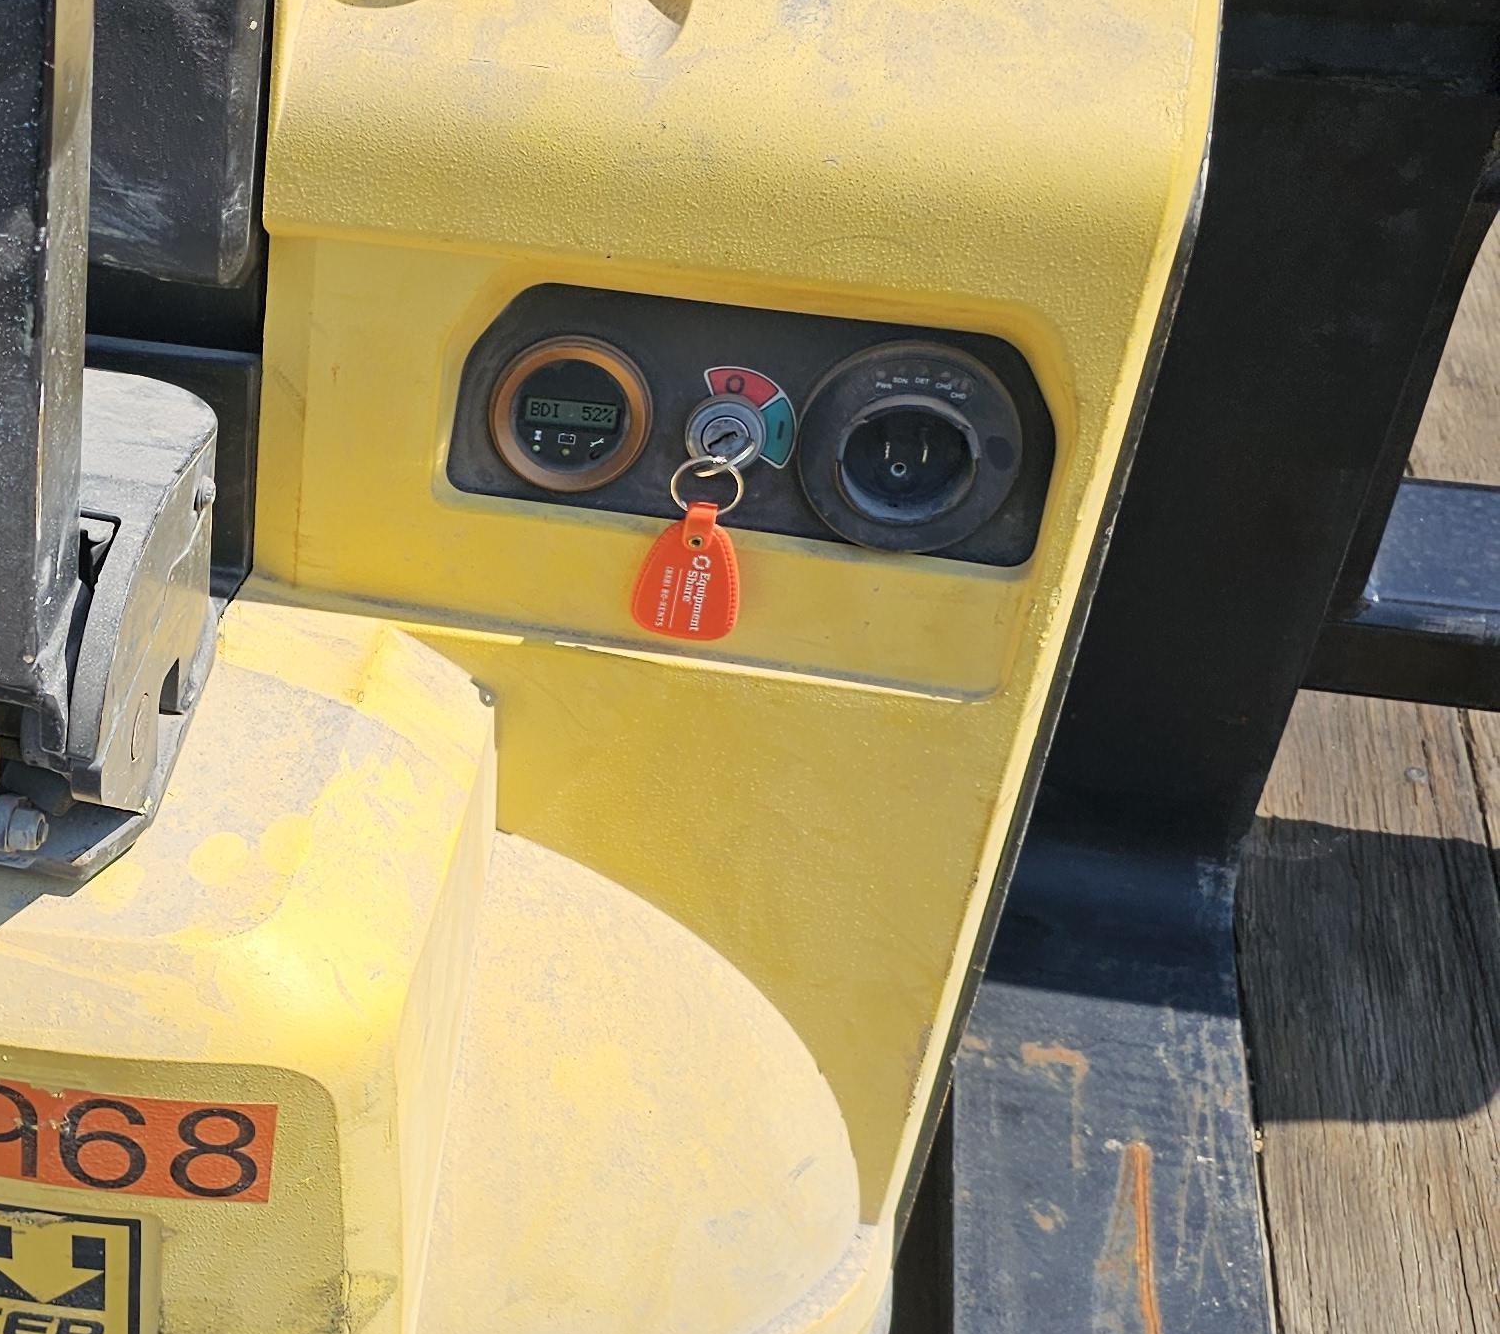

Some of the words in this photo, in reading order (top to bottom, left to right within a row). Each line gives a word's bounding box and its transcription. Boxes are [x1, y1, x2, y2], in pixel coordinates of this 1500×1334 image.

[530, 401, 560, 419] BDI
[581, 406, 615, 424] 52%
[682, 570, 698, 602] Share
[689, 572, 711, 631] Equipment
